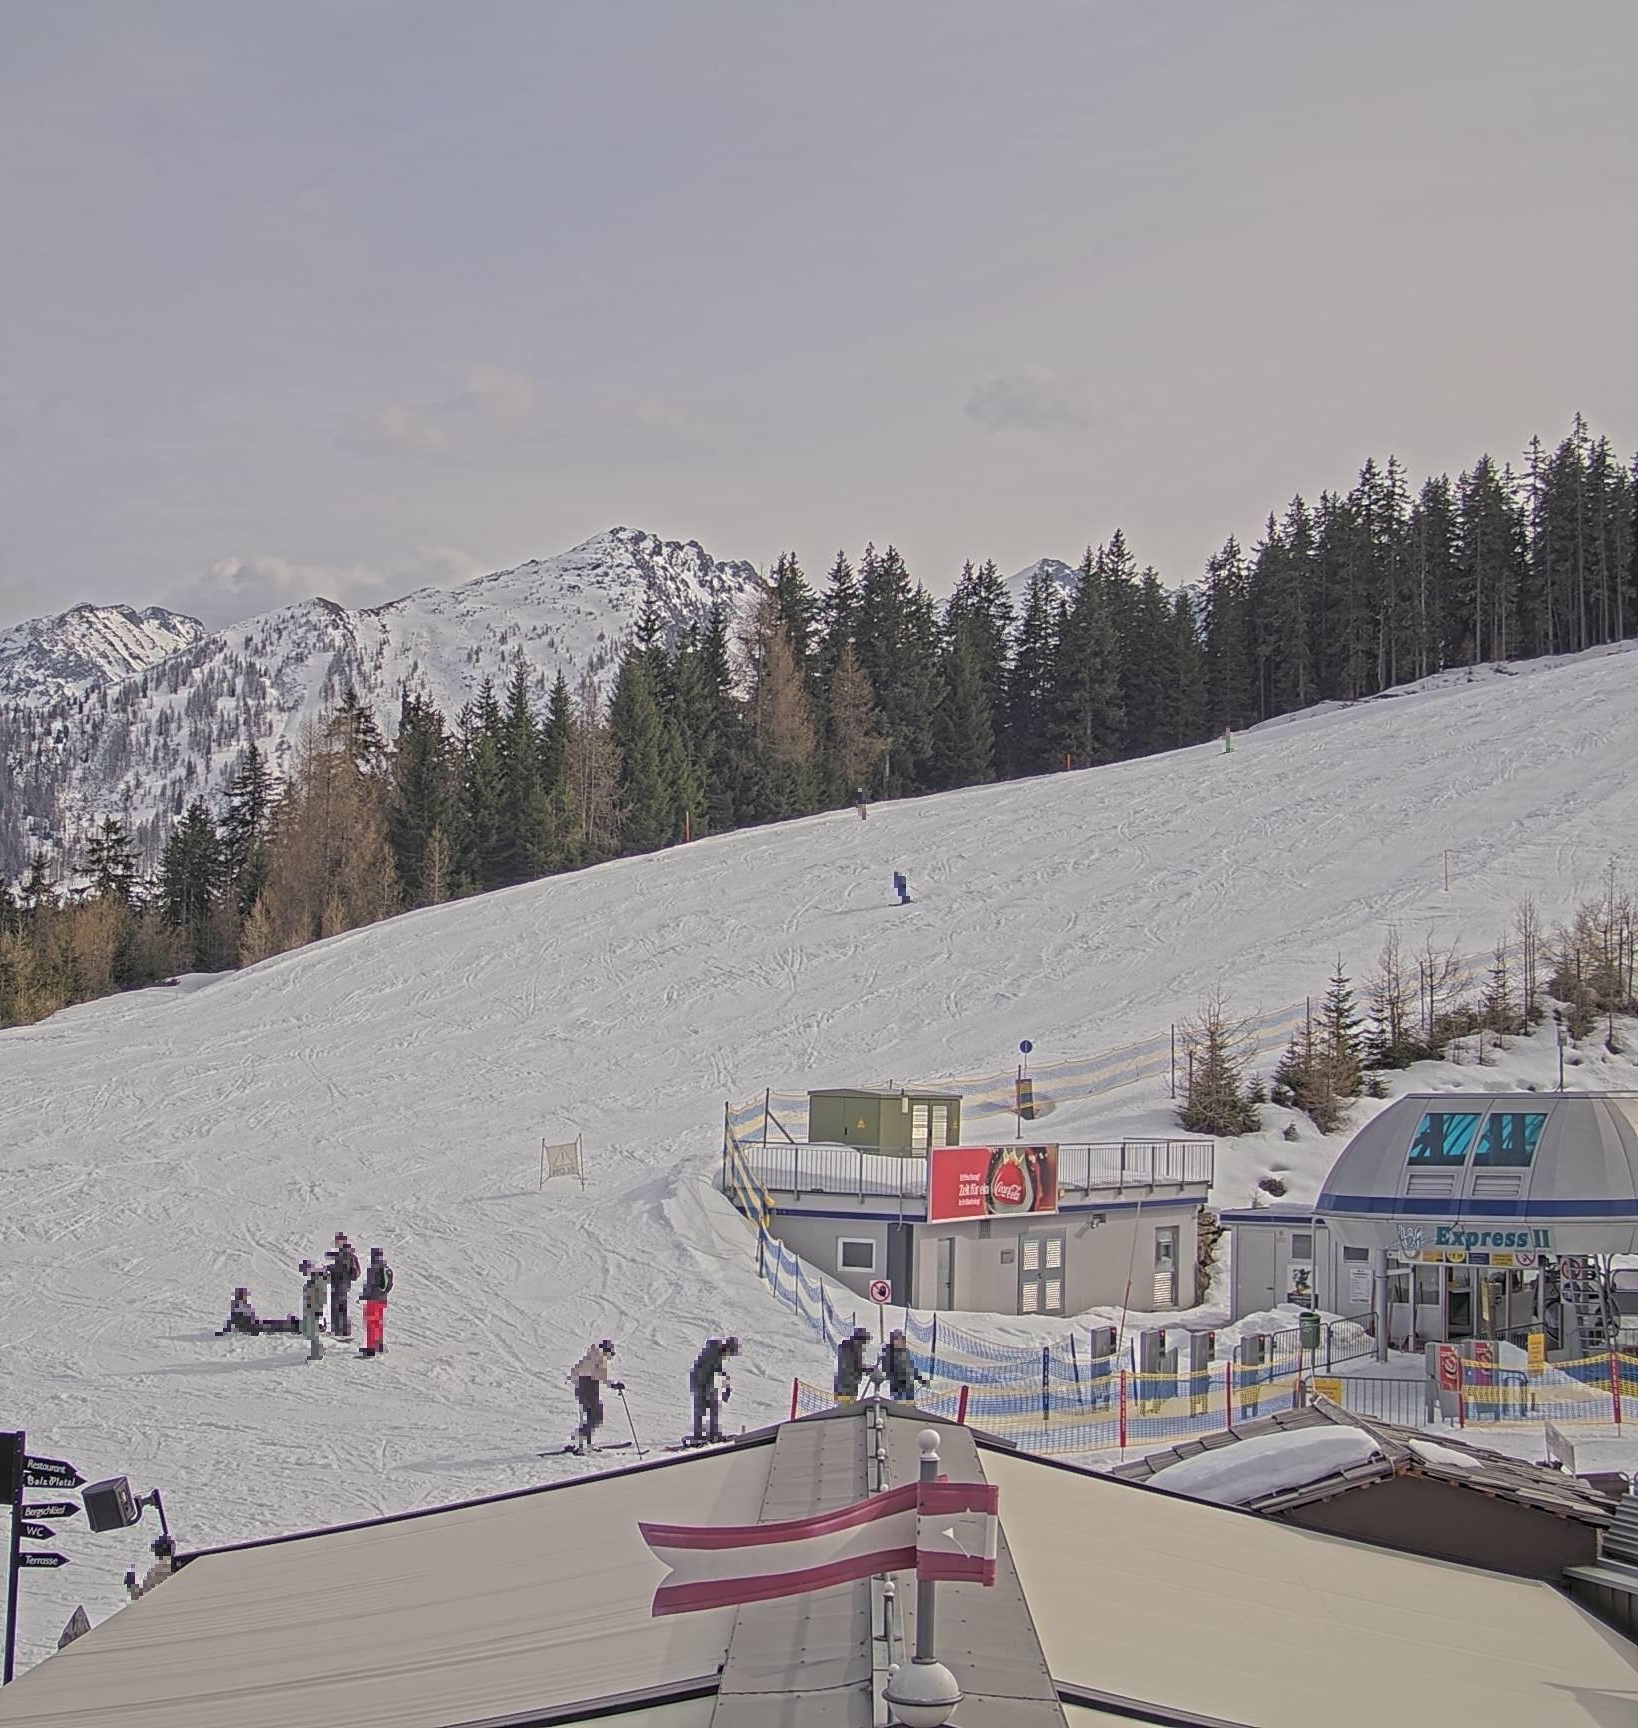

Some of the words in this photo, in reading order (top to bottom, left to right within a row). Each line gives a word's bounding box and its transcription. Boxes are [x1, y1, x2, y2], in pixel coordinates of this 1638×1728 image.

[1435, 1226, 1529, 1251] Express
[27, 1459, 67, 1474] Restaurant
[27, 1527, 44, 1537] WC
[25, 1555, 59, 1566] Terrasse
